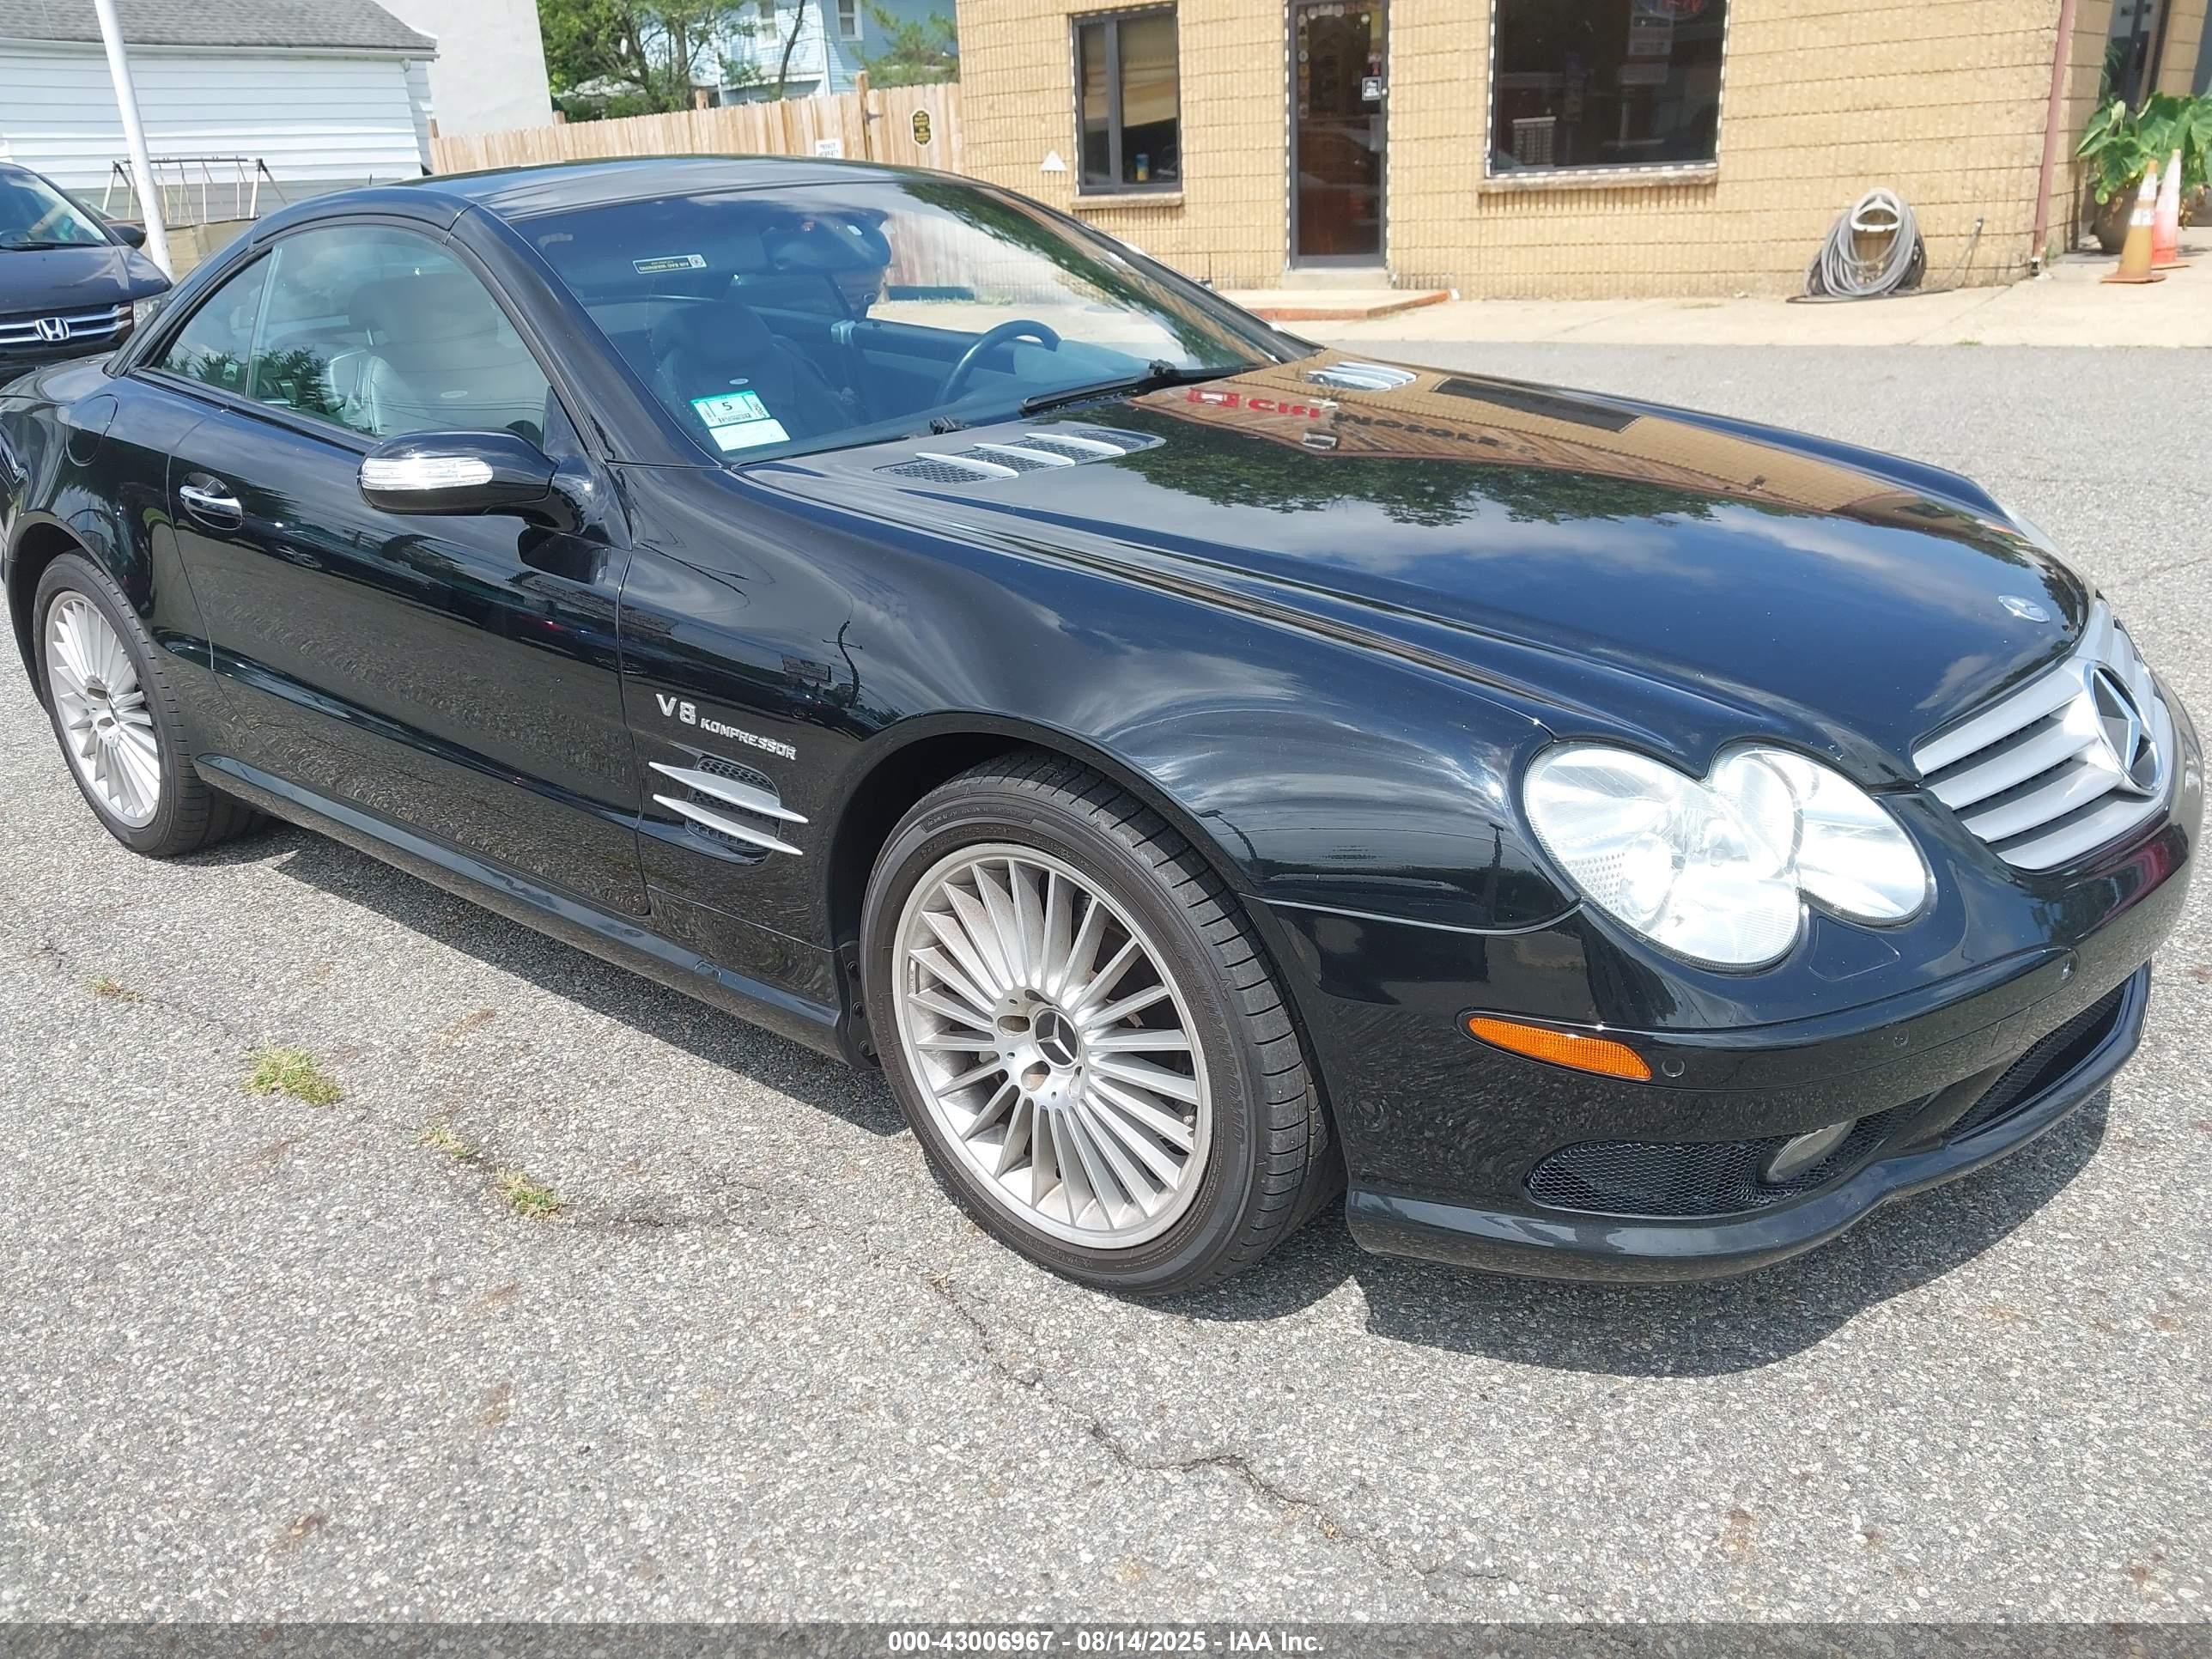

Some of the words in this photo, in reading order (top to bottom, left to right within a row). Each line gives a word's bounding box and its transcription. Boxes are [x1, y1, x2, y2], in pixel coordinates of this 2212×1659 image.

[721, 401, 733, 411] 5
[655, 693, 697, 726] V8
[700, 717, 797, 761] KOMPRESSOR
